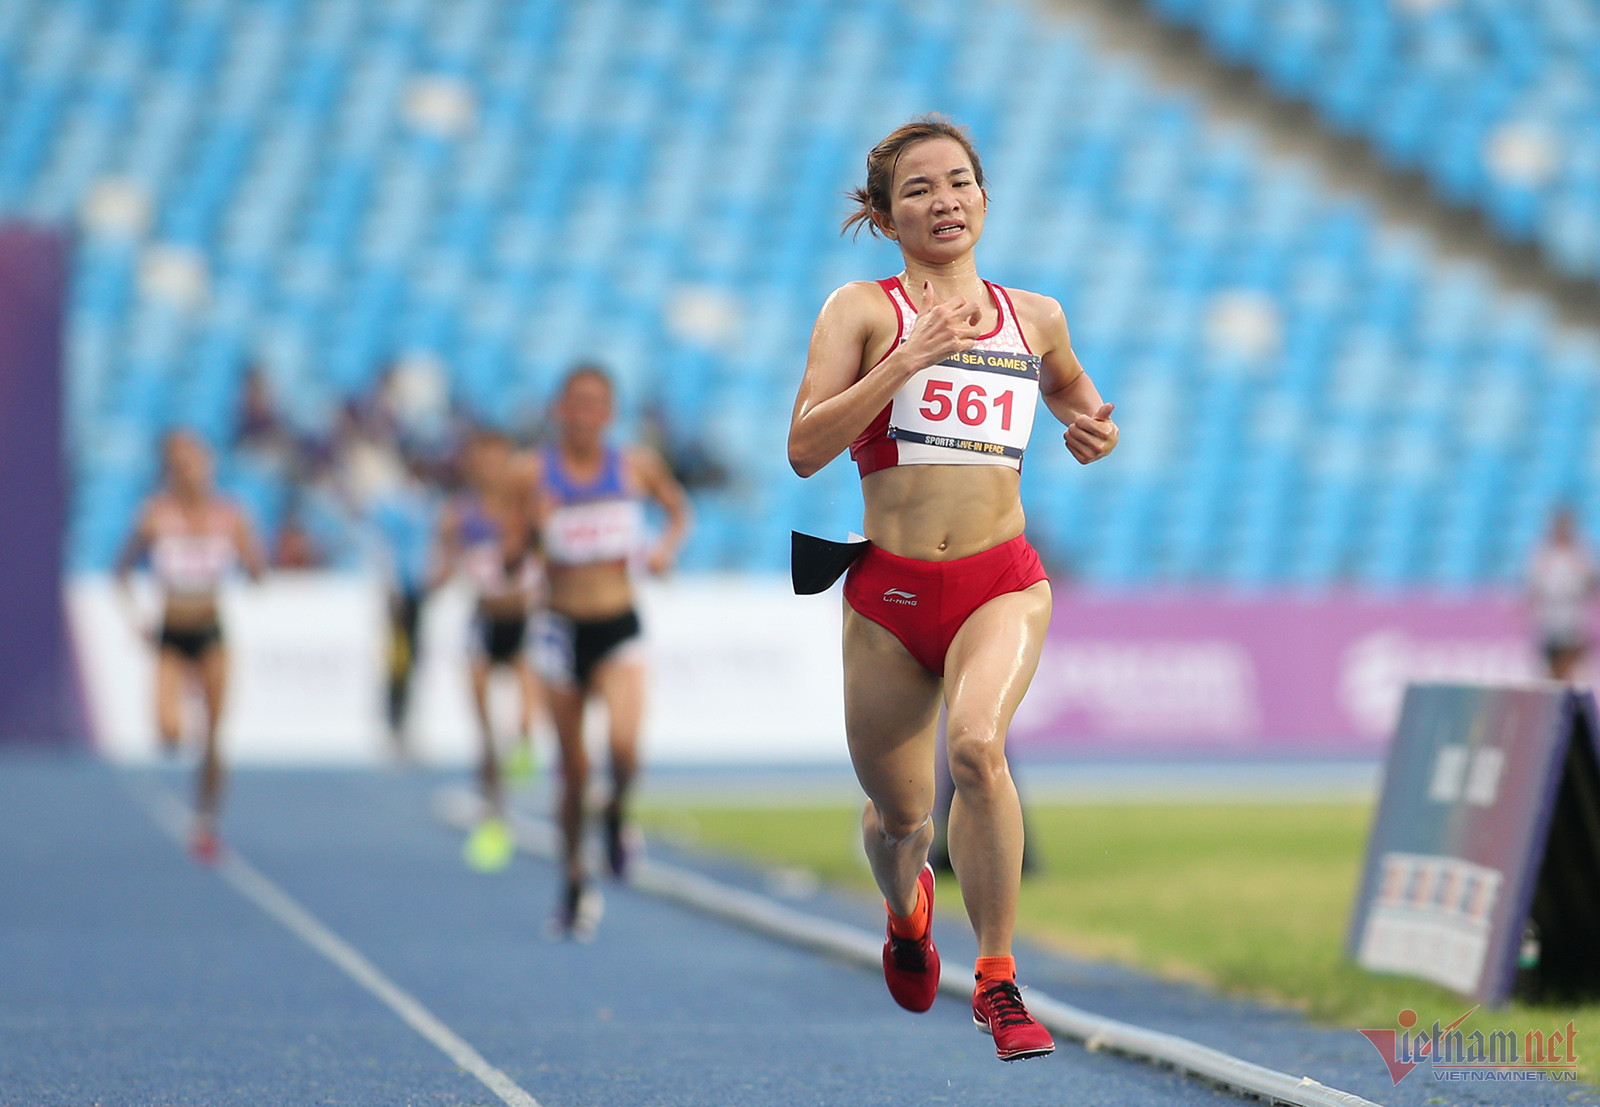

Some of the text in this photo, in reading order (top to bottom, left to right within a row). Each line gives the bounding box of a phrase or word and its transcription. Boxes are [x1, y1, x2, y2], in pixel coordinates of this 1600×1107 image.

[962, 353, 985, 366] SEA
[987, 356, 1028, 371] GAMES
[919, 379, 1013, 431] 561
[984, 443, 1005, 455] PEACE
[883, 597, 917, 606] LI-NING
